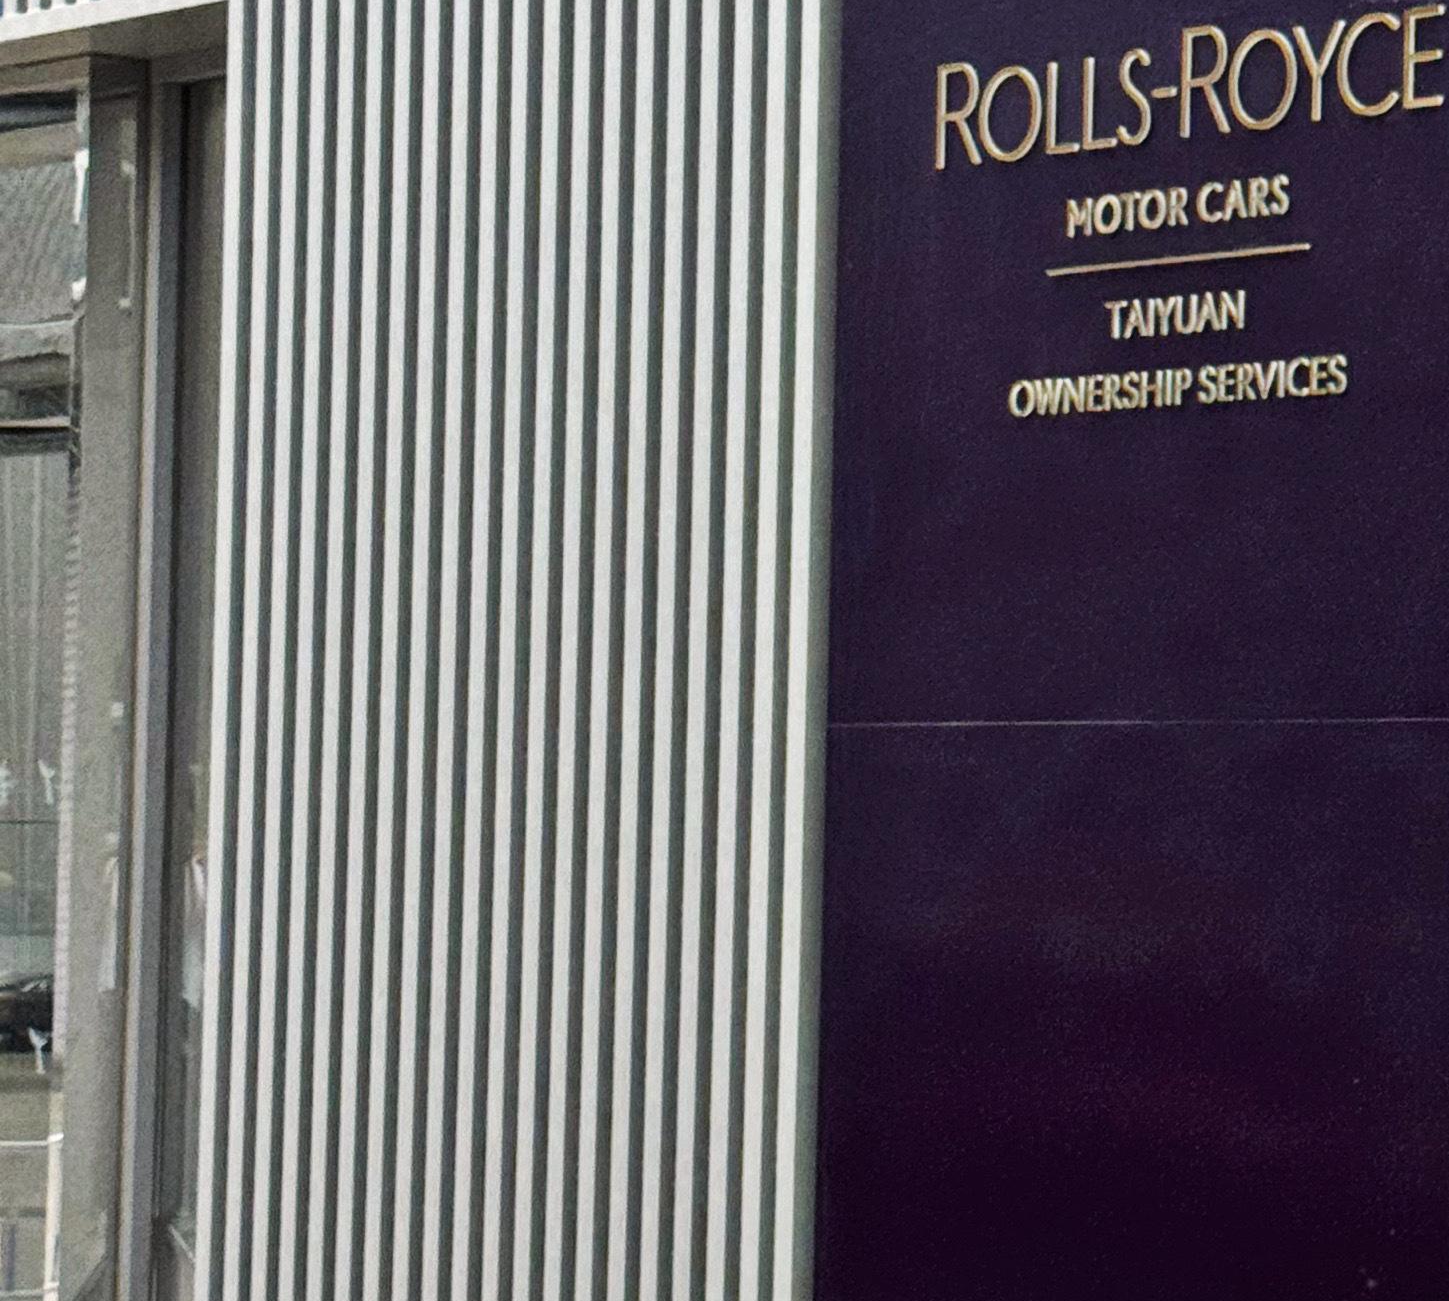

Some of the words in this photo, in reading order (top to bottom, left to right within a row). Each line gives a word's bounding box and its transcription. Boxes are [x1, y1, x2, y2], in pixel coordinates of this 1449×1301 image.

[935, 4, 1447, 170] ROLLS-ROYCE
[1066, 186, 1188, 238] MOTOR
[1196, 174, 1291, 223] CARS
[1105, 290, 1246, 340] TAIYUAN
[1008, 368, 1192, 418] OWNERSHIP
[1197, 353, 1348, 404] SERVICES
